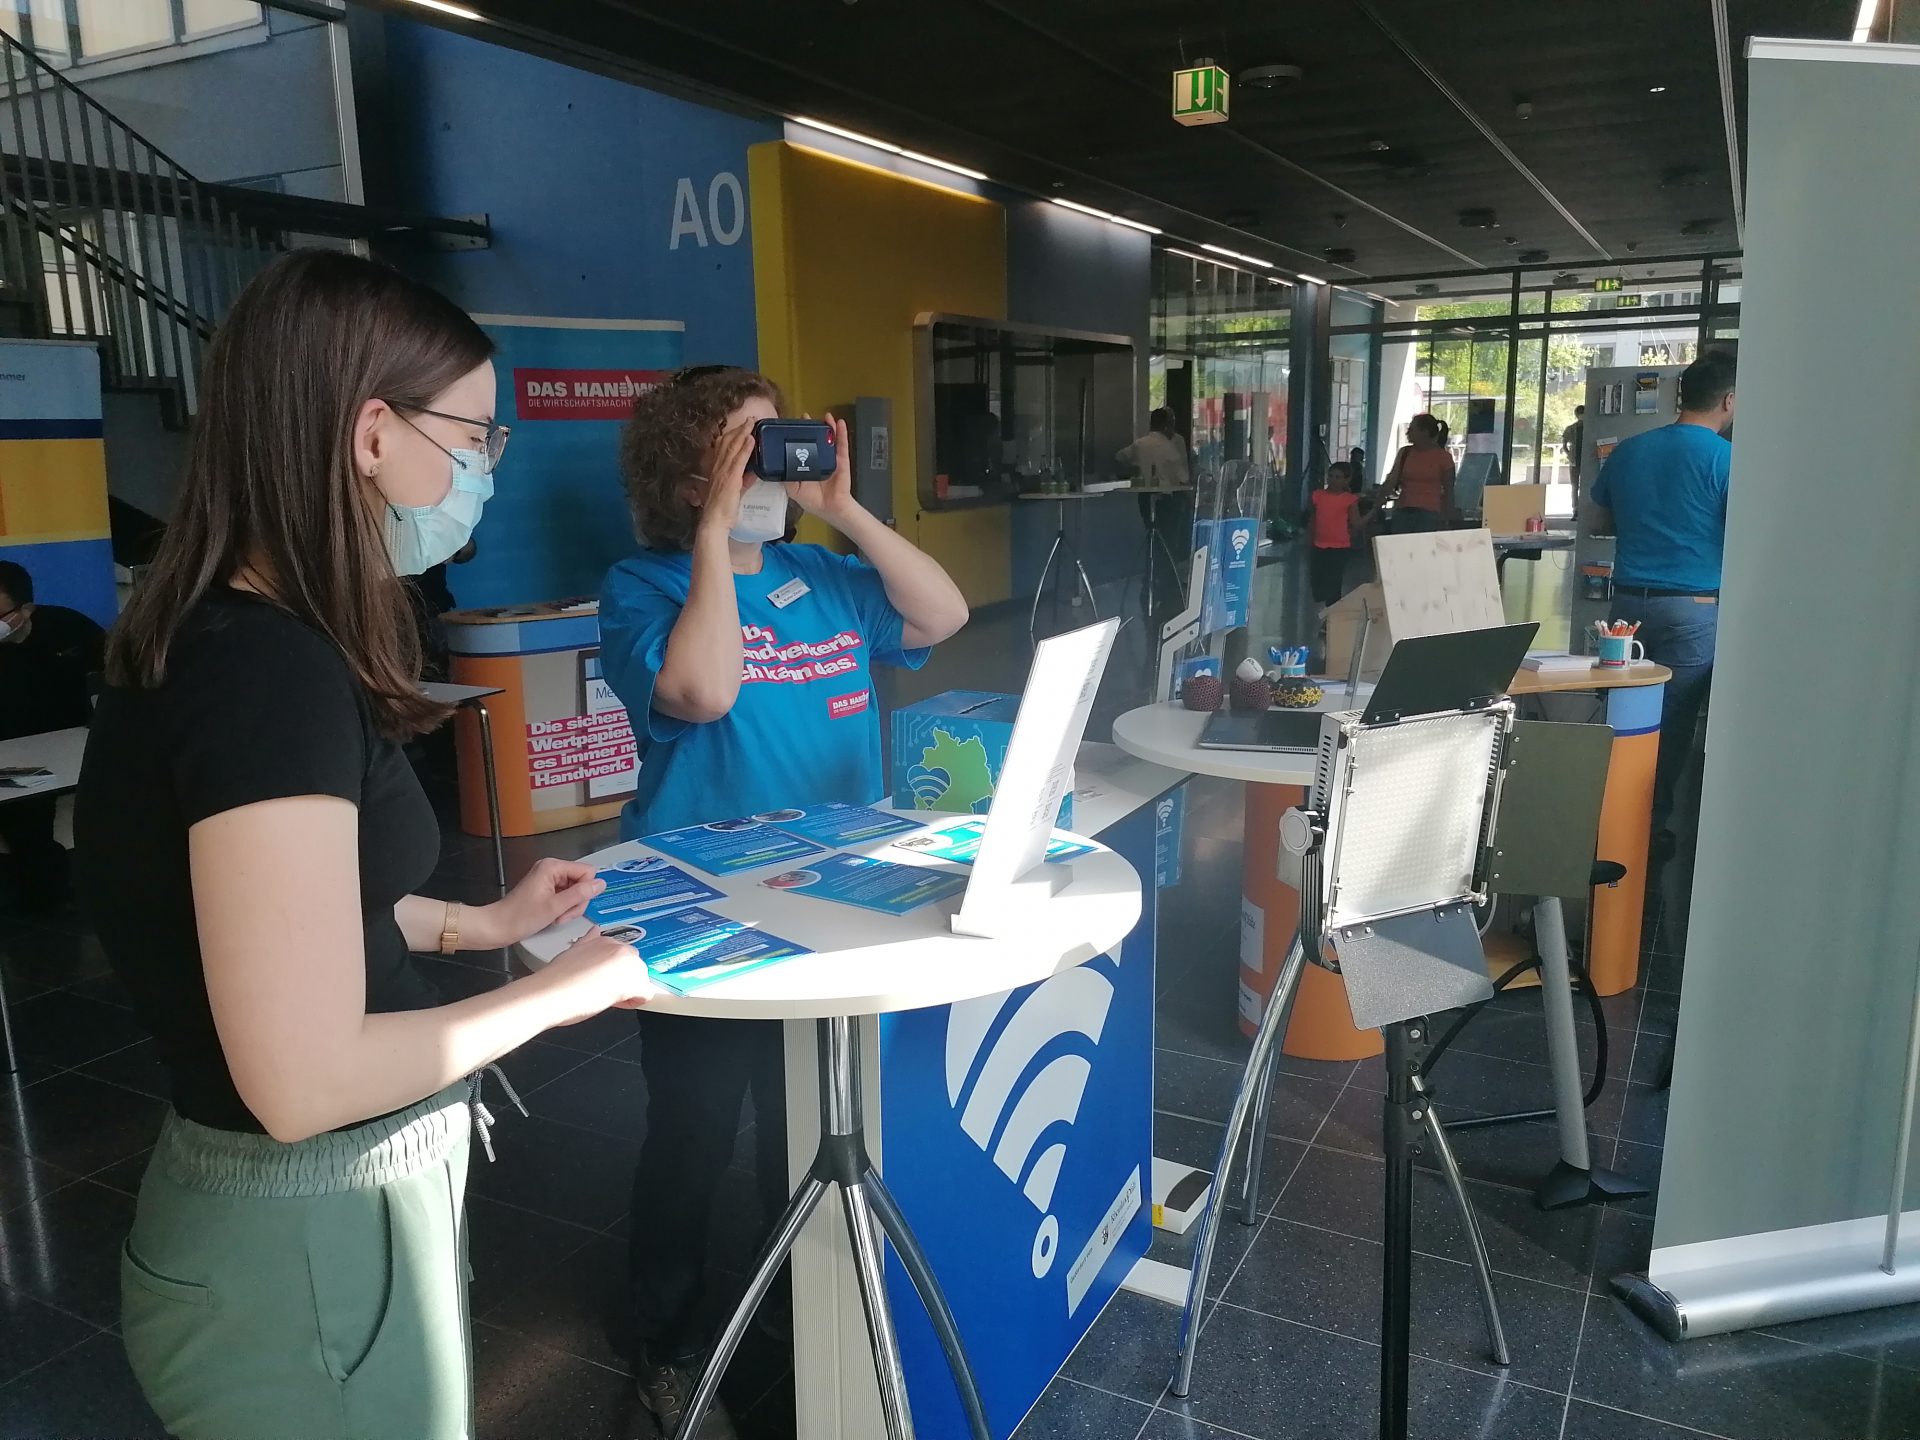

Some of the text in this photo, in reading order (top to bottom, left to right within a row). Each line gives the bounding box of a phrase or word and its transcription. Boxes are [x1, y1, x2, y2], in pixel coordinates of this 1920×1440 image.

[527, 375, 660, 398] DAS HANDW
[528, 399, 542, 408] DIE
[832, 699, 849, 710] DAS
[531, 721, 563, 735] Die
[533, 758, 558, 770] es
[561, 746, 618, 766] immer
[534, 760, 632, 787] Handwerk.
